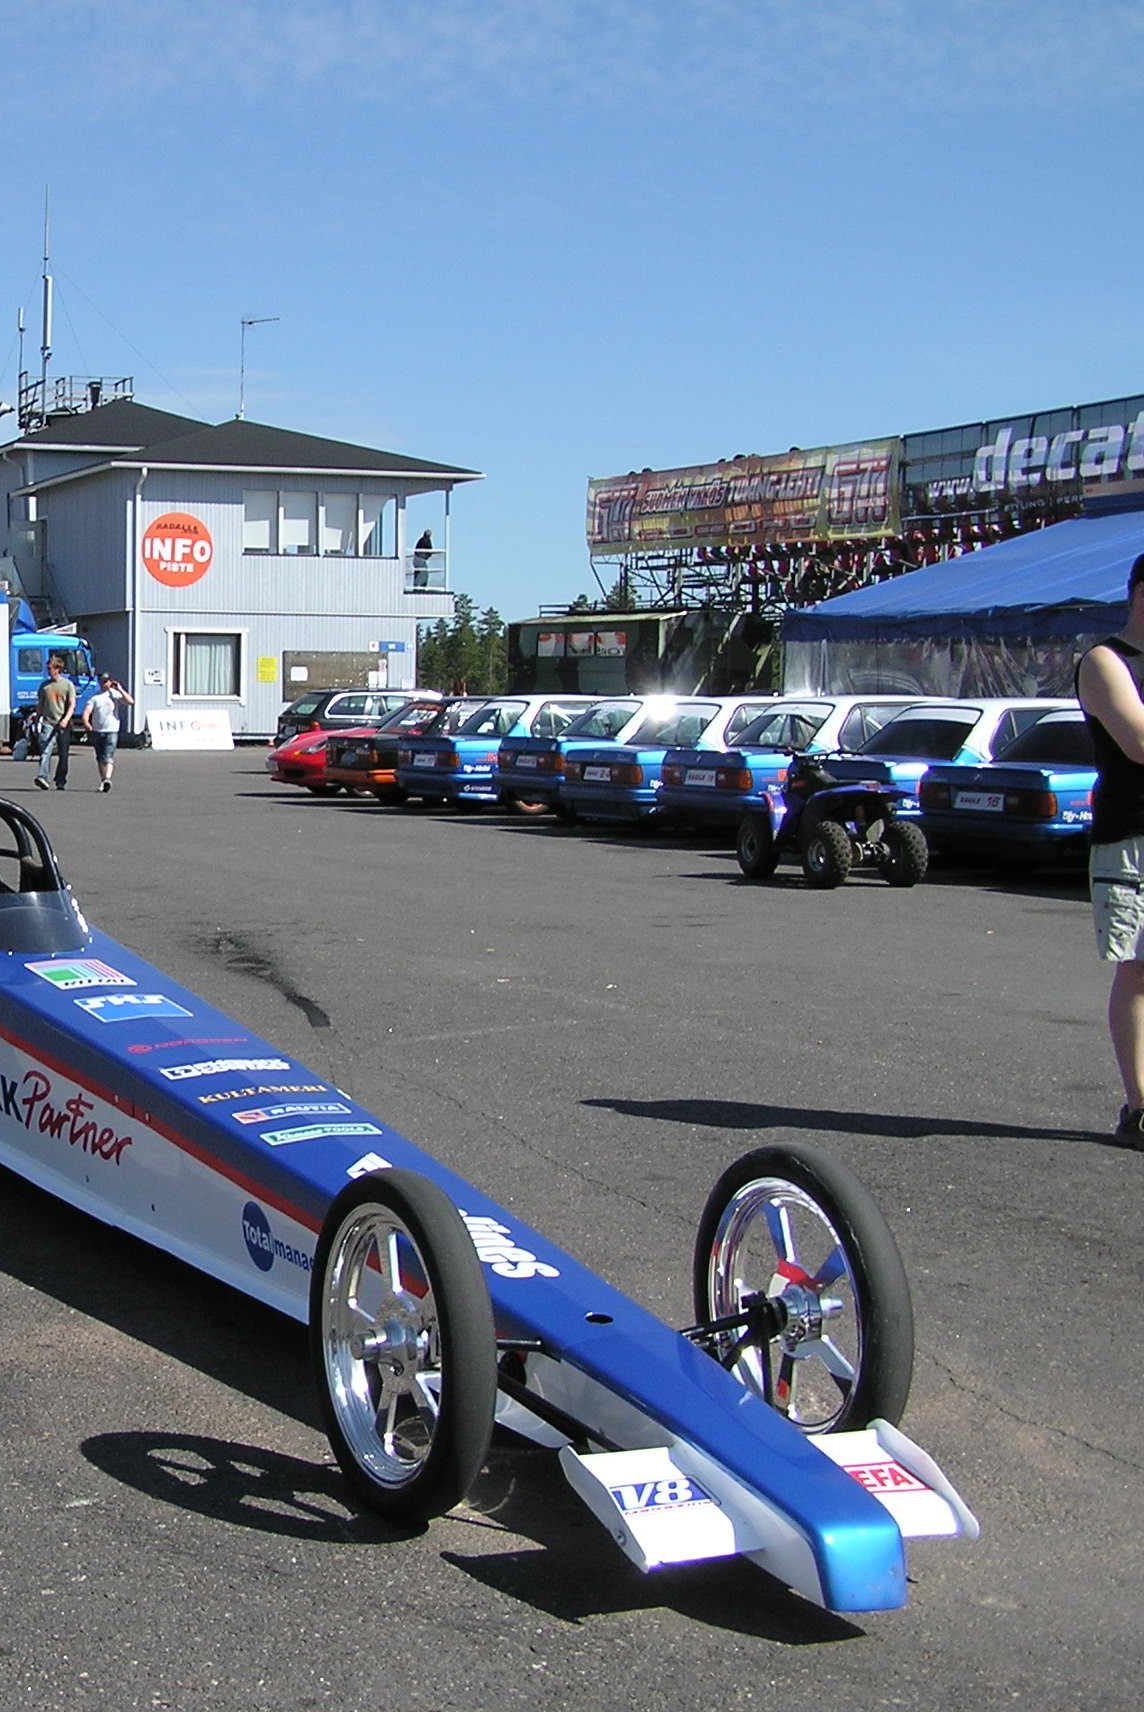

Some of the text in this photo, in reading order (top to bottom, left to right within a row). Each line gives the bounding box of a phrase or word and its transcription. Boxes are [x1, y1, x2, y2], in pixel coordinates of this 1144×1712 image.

[144, 537, 212, 563] INFO
[159, 561, 195, 573] PISTE
[159, 721, 201, 731] INFO
[198, 1084, 329, 1104] KULTAMERI
[21, 1070, 134, 1166] Partner
[270, 1105, 340, 1115] RAUTIA
[849, 1467, 915, 1488] EFA
[612, 1479, 694, 1509] V8
